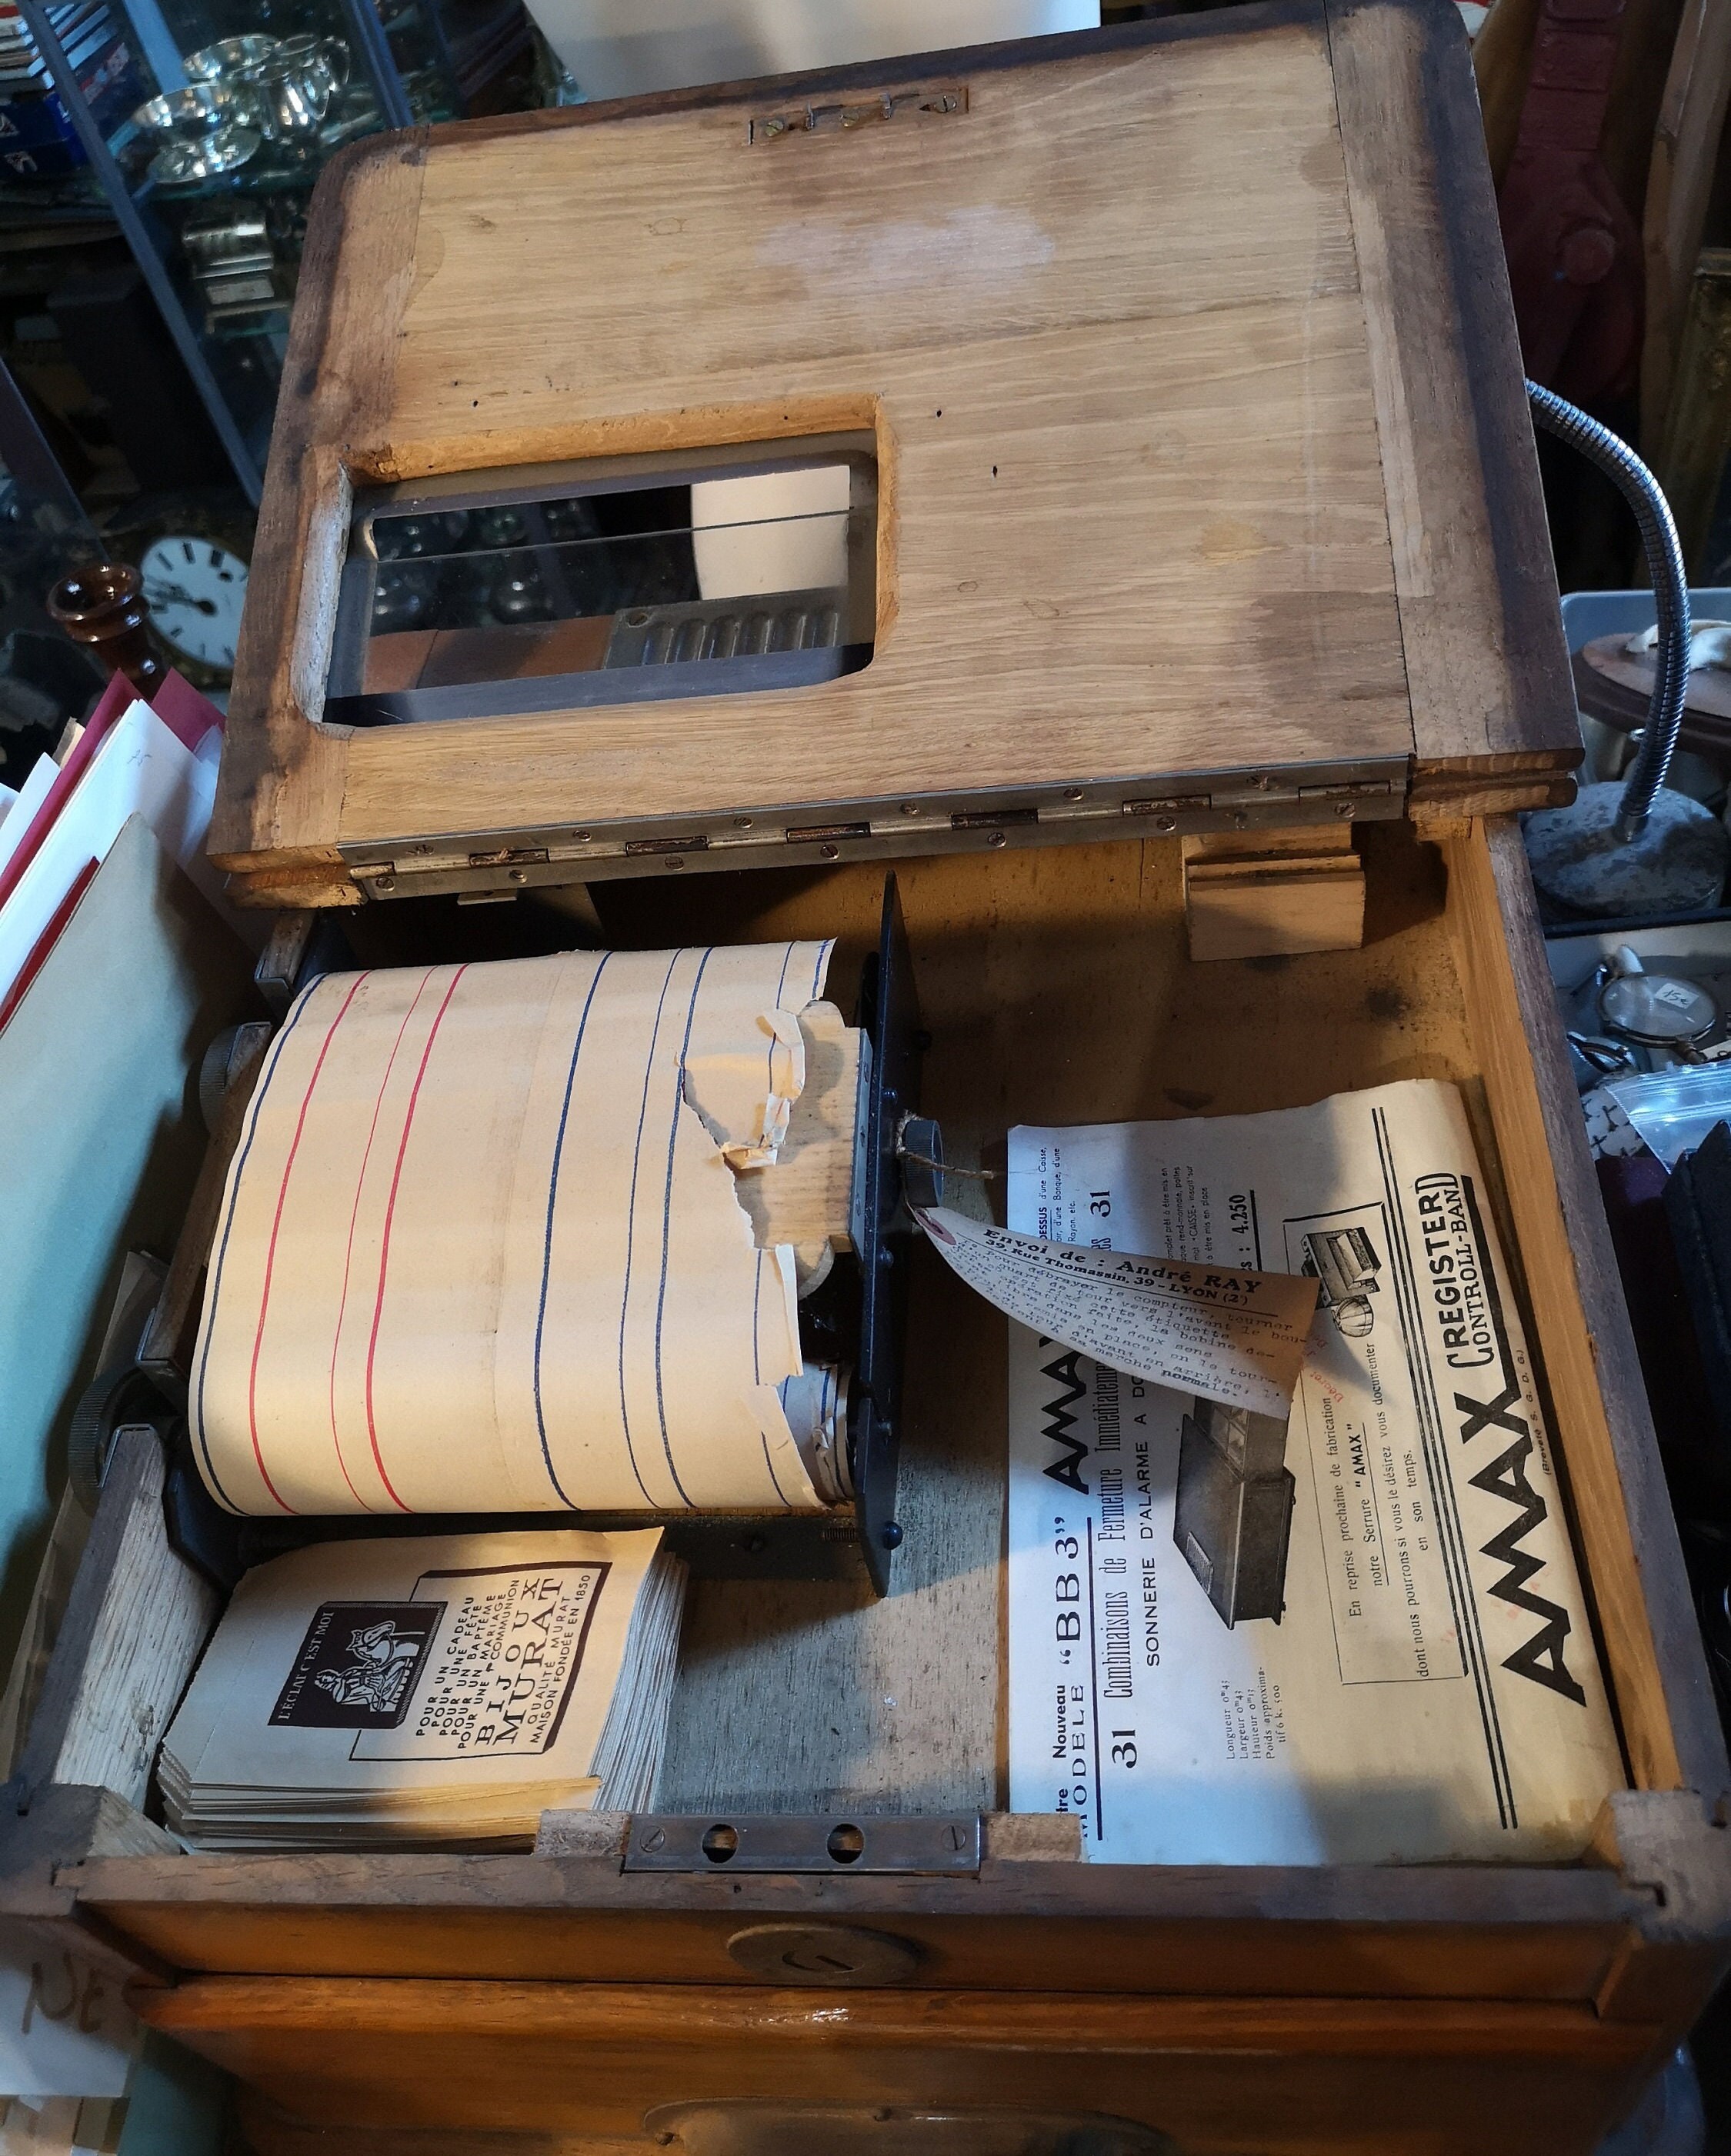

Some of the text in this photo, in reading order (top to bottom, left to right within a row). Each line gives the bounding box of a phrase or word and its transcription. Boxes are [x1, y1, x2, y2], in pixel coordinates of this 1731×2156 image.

[1039, 1148, 1047, 1172] Caisse,
[1053, 1172, 1062, 1200] Banque,
[1053, 1207, 1062, 1226] d'une
[1089, 1191, 1111, 1217] 31
[1229, 1195, 1249, 1234] 4.250
[983, 1229, 1048, 1255] Envoi
[1060, 1251, 1086, 1263] de
[1116, 1261, 1192, 1282] André
[1204, 1275, 1262, 1293] RAY
[1011, 1248, 1040, 1261] Rue
[1134, 1276, 1155, 1287] 39
[1169, 1284, 1218, 1300] LYON
[1166, 1235, 1174, 1258] omplet
[1134, 1414, 1146, 1425] A
[1322, 1398, 1339, 1455] fabrication
[1516, 1350, 1552, 1475] (Breveté S. G. D. G.)
[1135, 1441, 1154, 1540] D'ALARME
[1330, 1464, 1341, 1477] de
[1096, 1468, 1126, 1541] Fermeture
[1333, 1485, 1353, 1541] prochaine
[1359, 1498, 1376, 1543] Serrure
[1366, 1344, 1429, 1677] dont nous pourrons si vous le désirez vous documenter
[1403, 1450, 1429, 1551] en son temps.
[1099, 1558, 1126, 1574] de
[1343, 1550, 1359, 1590] reprise
[1369, 1555, 1382, 1586] notre
[1453, 1392, 1587, 1708] AMAX
[315, 1611, 335, 1635] MOI
[1142, 1558, 1159, 1667] SONNERIE
[1349, 1601, 1362, 1617] En
[415, 1597, 475, 1736] POUR UN CADEAU
[431, 1606, 482, 1727] POUR UNE FÊTE
[439, 1698, 460, 1735] POUR
[456, 1669, 471, 1686] UN
[466, 1595, 495, 1660] BAPTÊME
[451, 1698, 472, 1734] POUR
[468, 1670, 482, 1688] UN
[479, 1594, 506, 1660] MARIAGE
[457, 1580, 519, 1748] POUR UNE COMMUNION
[474, 1578, 540, 1745] BIJOUX
[492, 1578, 564, 1745] MURAT
[527, 1596, 571, 1724] QUALITÉ MURAT
[529, 1575, 591, 1743] MAISON FONDÉE EN 1850
[1100, 1591, 1133, 1698] Combinaisons
[1224, 1709, 1236, 1759] Longueur
[1238, 1718, 1249, 1759] Largeur
[1250, 1715, 1261, 1759] Hauteur
[1258, 1667, 1275, 1759] Poids approxima-
[1276, 1731, 1286, 1743] tif
[1052, 1685, 1069, 1812] tre Nouveau
[1112, 1730, 1137, 1768] 31
